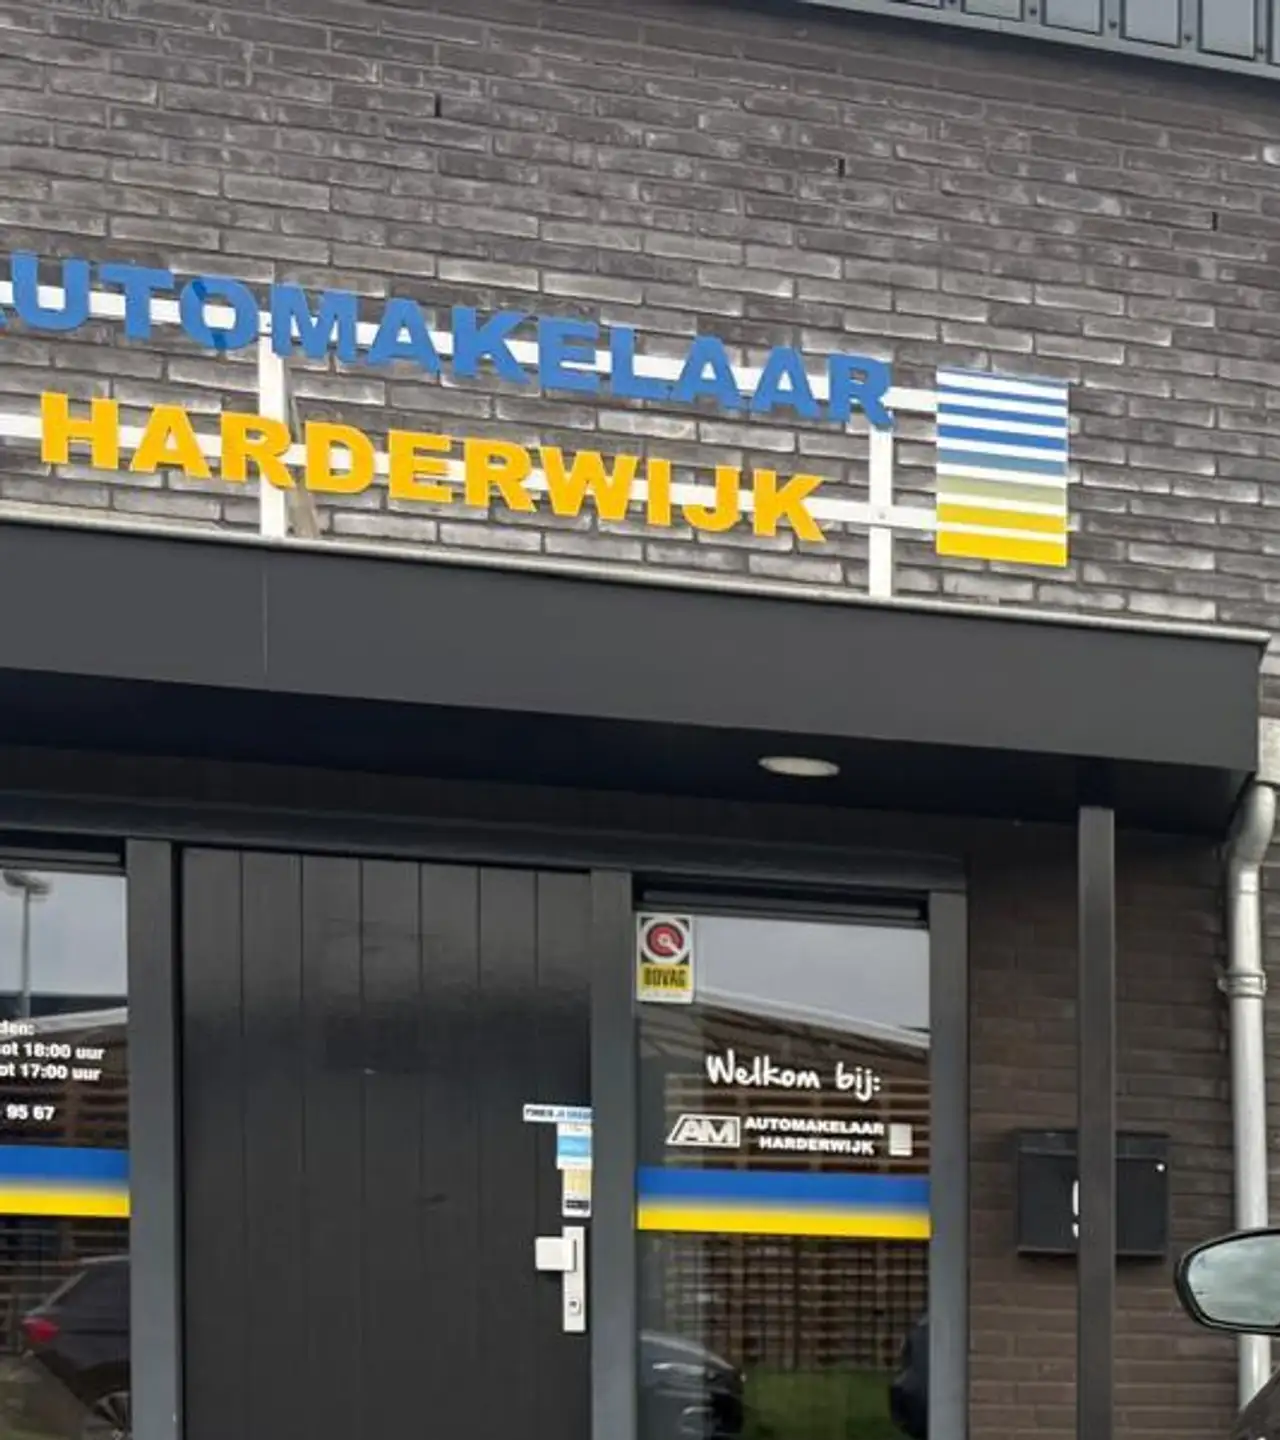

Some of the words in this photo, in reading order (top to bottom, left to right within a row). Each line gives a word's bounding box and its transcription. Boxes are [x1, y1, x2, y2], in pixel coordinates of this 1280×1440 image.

[0, 248, 897, 430] UTOMAKELAAR
[39, 391, 827, 543] HARDERWIJK
[23, 1042, 72, 1059] 18:00
[75, 1047, 106, 1061] uur
[20, 1062, 69, 1080] 17:00
[71, 1067, 103, 1082] uur
[705, 1048, 822, 1091] Welkom
[834, 1061, 882, 1103] bij:
[6, 1103, 29, 1120] 95
[33, 1105, 56, 1121] 67
[672, 1116, 738, 1147] AM
[744, 1115, 885, 1136] AUTOMAKELAAR
[758, 1135, 876, 1155] HARDERWIJK
